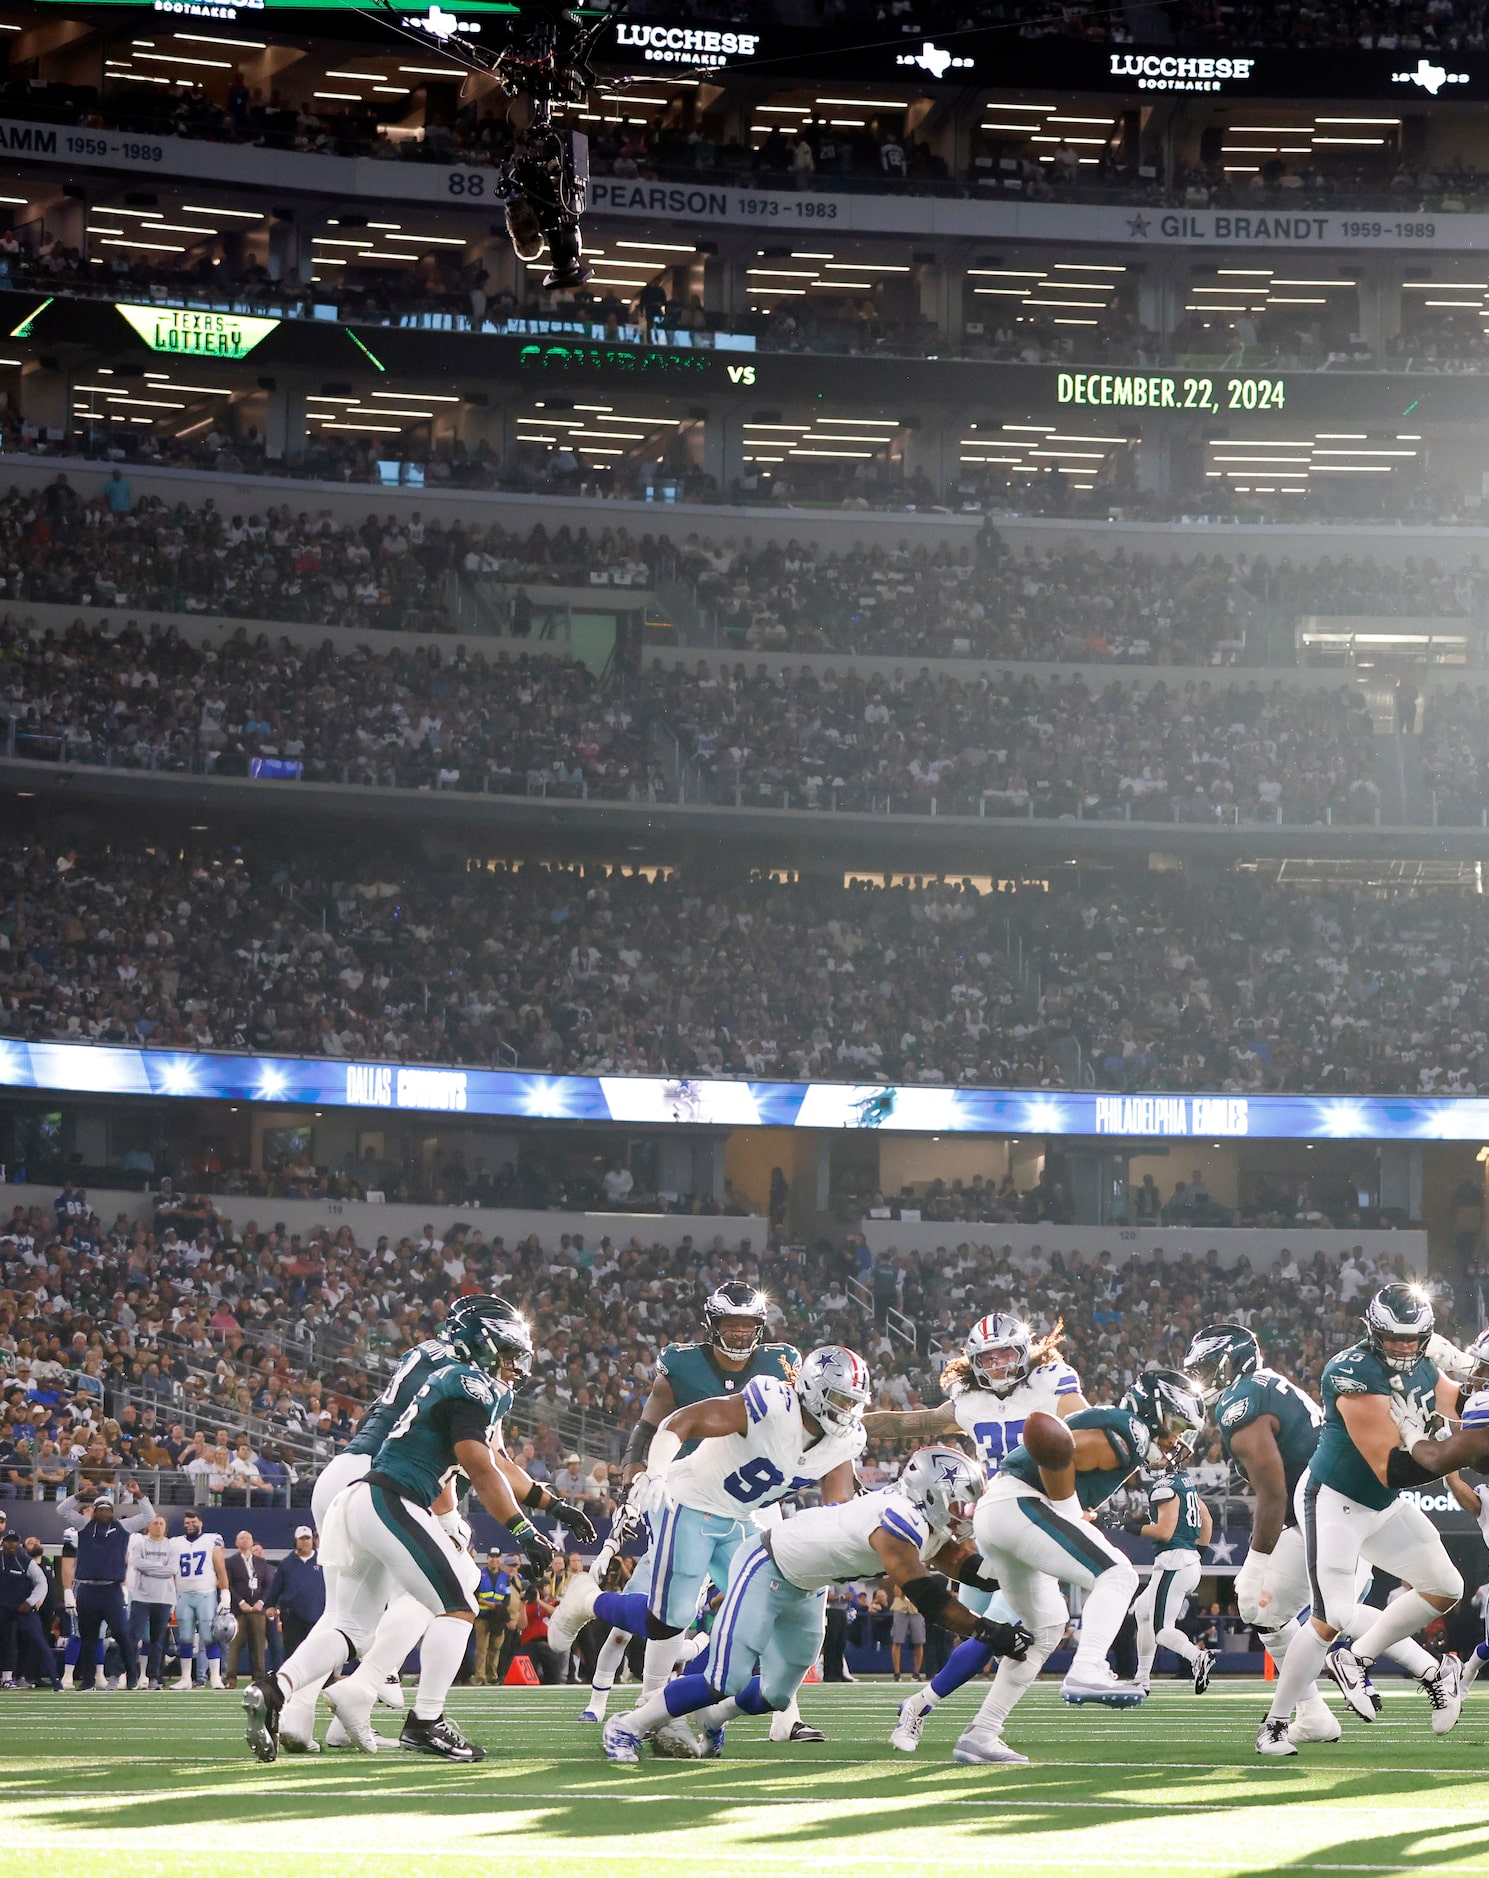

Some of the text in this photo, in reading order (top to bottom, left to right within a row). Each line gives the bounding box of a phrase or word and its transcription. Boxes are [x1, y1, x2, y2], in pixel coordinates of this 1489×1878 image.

[153, 1, 238, 20] BOOTMAKER
[616, 23, 757, 56] LUCCHESE
[644, 49, 727, 67] BOOTMAKER
[1109, 54, 1251, 79] LUCCHESE
[1137, 78, 1222, 92] BOOTMAKER
[447, 172, 485, 197] 88
[592, 184, 728, 216] PEARSON
[1160, 215, 1205, 238] GIL
[1214, 216, 1329, 240] BRANDT
[173, 312, 225, 333] TEXAS
[154, 323, 242, 355] LOTTERY
[727, 365, 757, 386] VS
[1227, 379, 1286, 410] 2024
[346, 1065, 392, 1106] DALLAS
[1095, 1097, 1188, 1135] PHILADELPHIA
[179, 1550, 207, 1578] 67
[519, 1658, 538, 1681] 20
